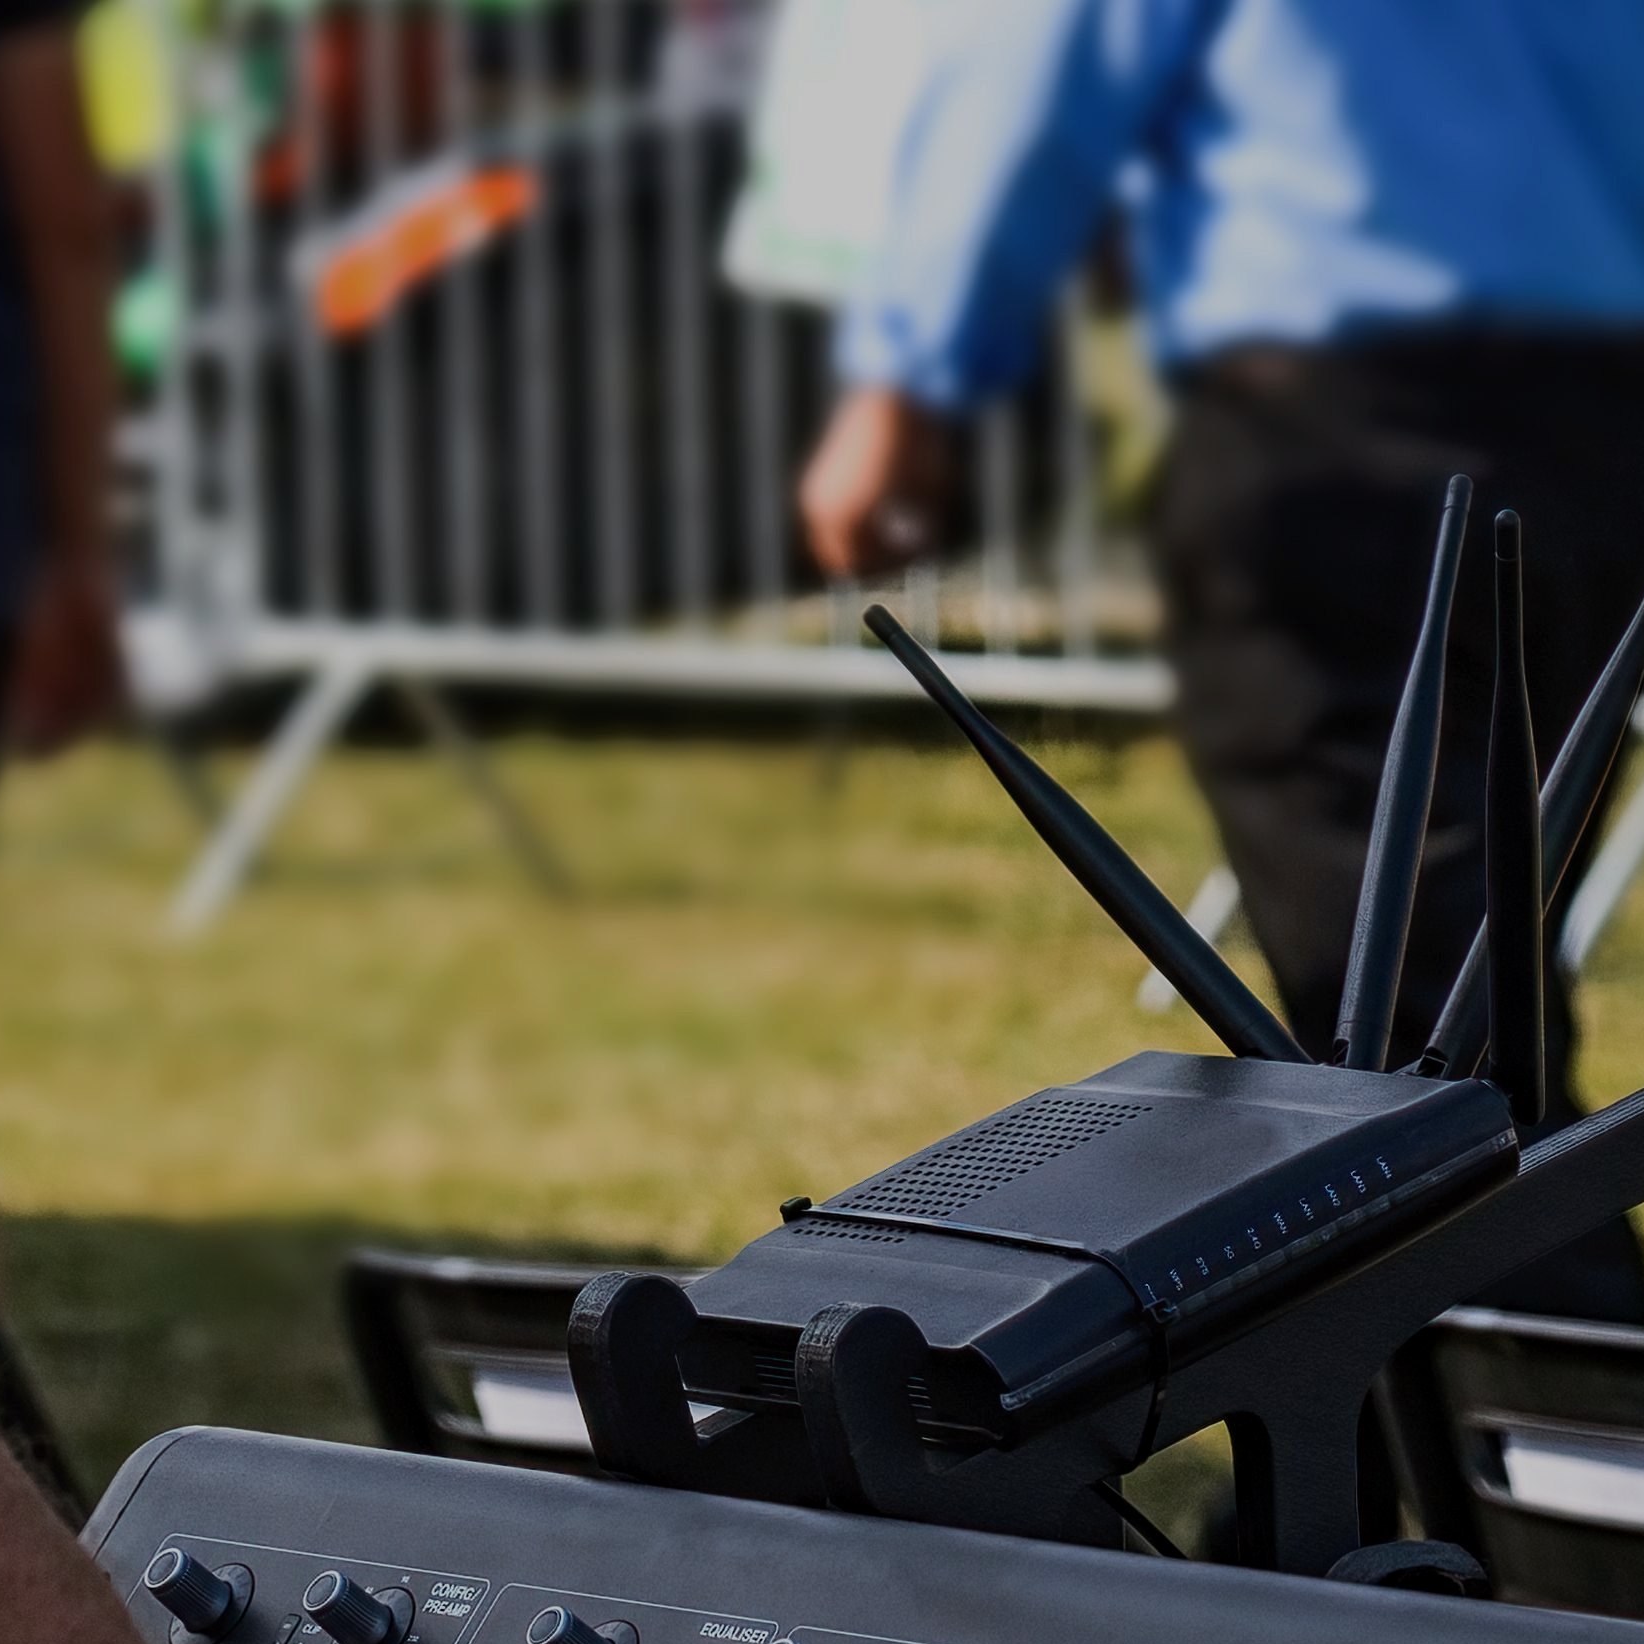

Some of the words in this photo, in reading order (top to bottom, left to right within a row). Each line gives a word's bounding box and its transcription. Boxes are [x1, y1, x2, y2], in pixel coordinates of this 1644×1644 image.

[430, 1582, 482, 1600] CONFIG/
[421, 1599, 472, 1617] PREAMP
[699, 1622, 769, 1644] EQUALISER
